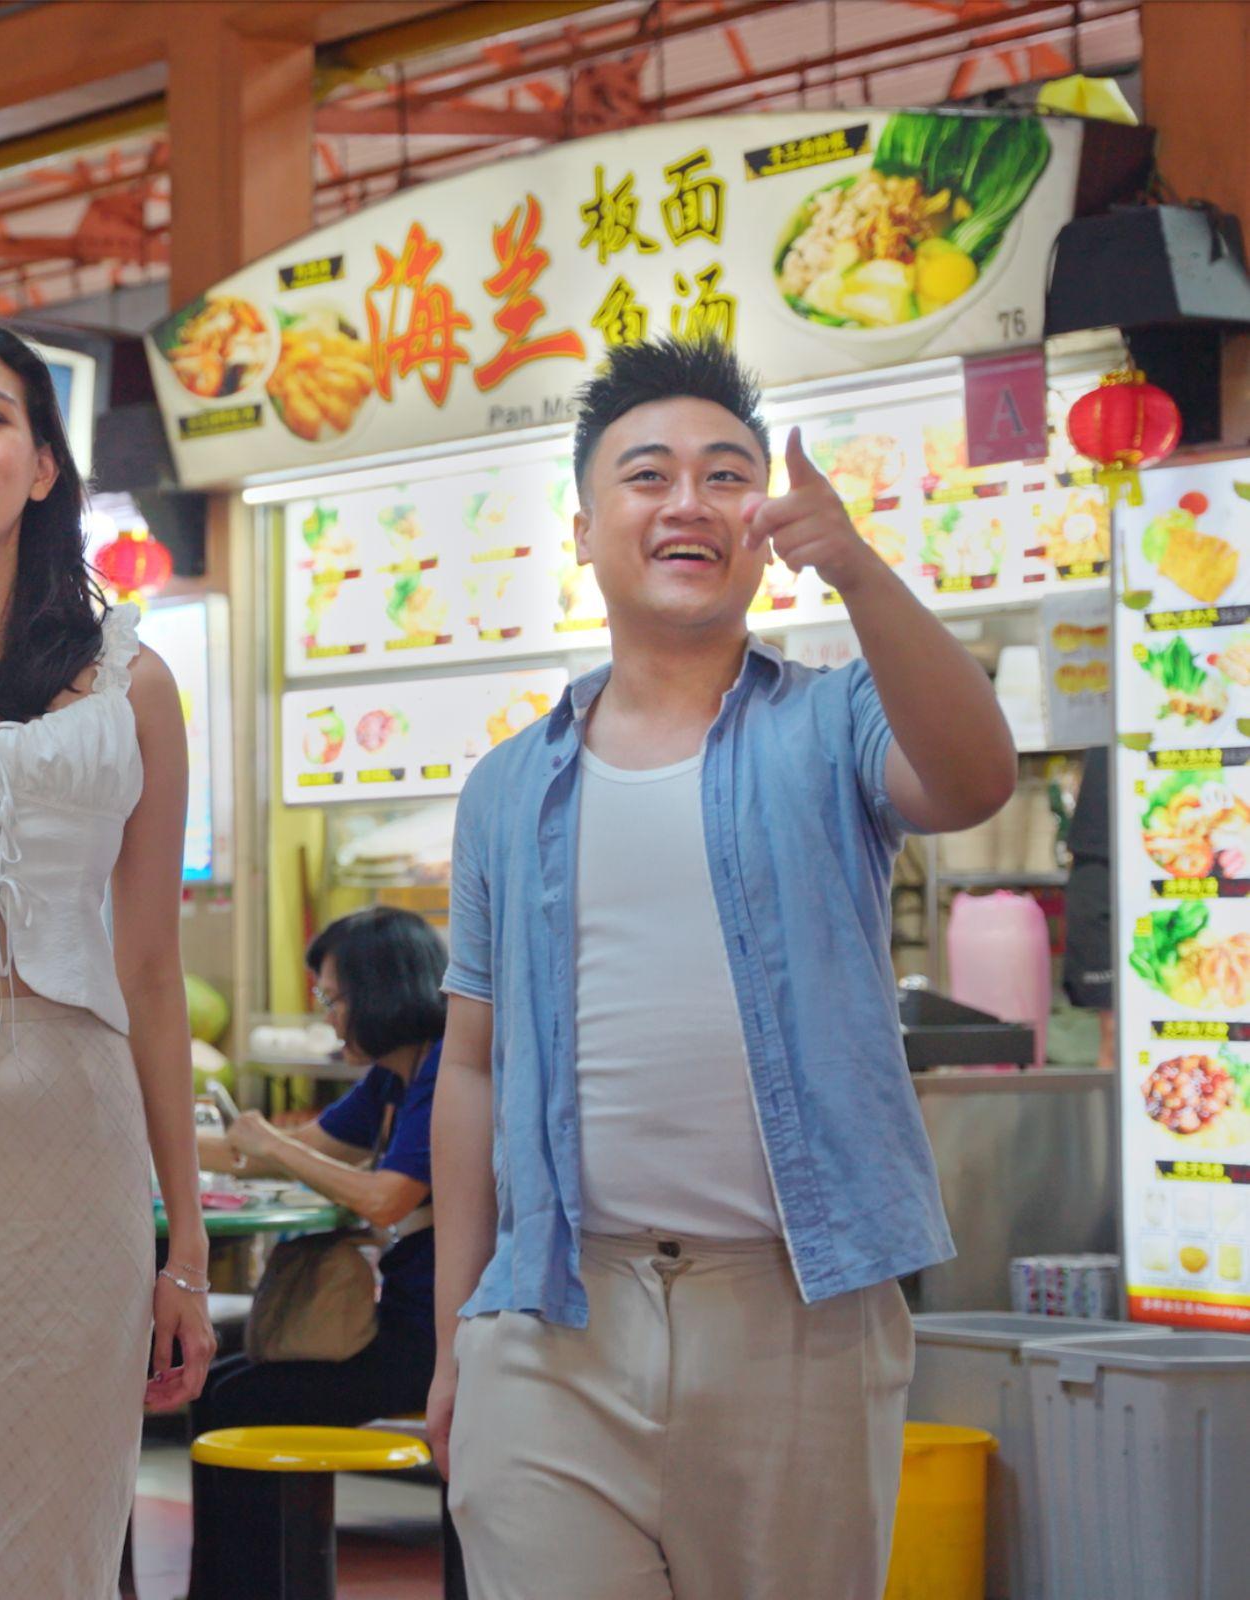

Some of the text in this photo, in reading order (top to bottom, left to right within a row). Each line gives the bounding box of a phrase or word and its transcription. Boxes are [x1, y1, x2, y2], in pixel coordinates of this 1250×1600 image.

[579, 148, 727, 266] 板面
[365, 192, 586, 408] 海兰
[997, 308, 1026, 339] 76
[489, 403, 534, 428] Pan
[988, 384, 1028, 440] A
